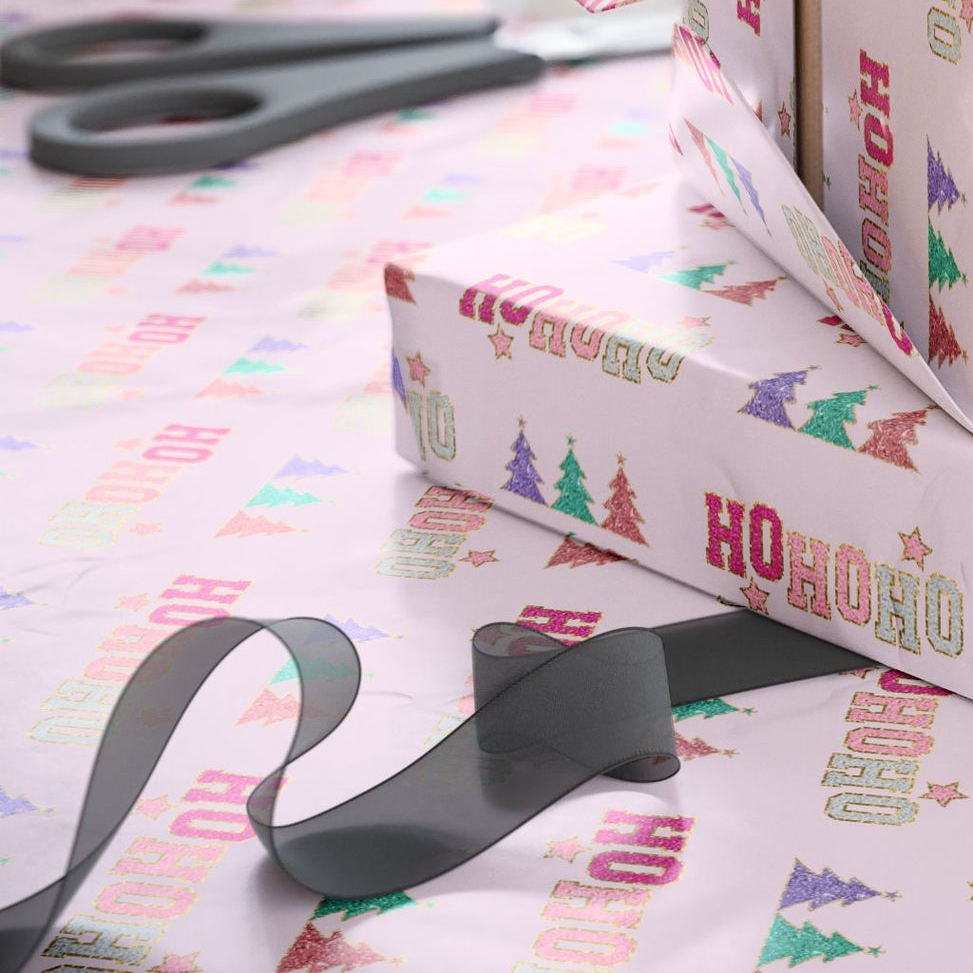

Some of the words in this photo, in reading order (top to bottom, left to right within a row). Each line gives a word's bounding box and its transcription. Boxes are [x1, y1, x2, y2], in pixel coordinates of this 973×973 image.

[704, 491, 964, 659] HOHOHO
[40, 769, 290, 973] HOHOH
[511, 809, 696, 973] HOHO
